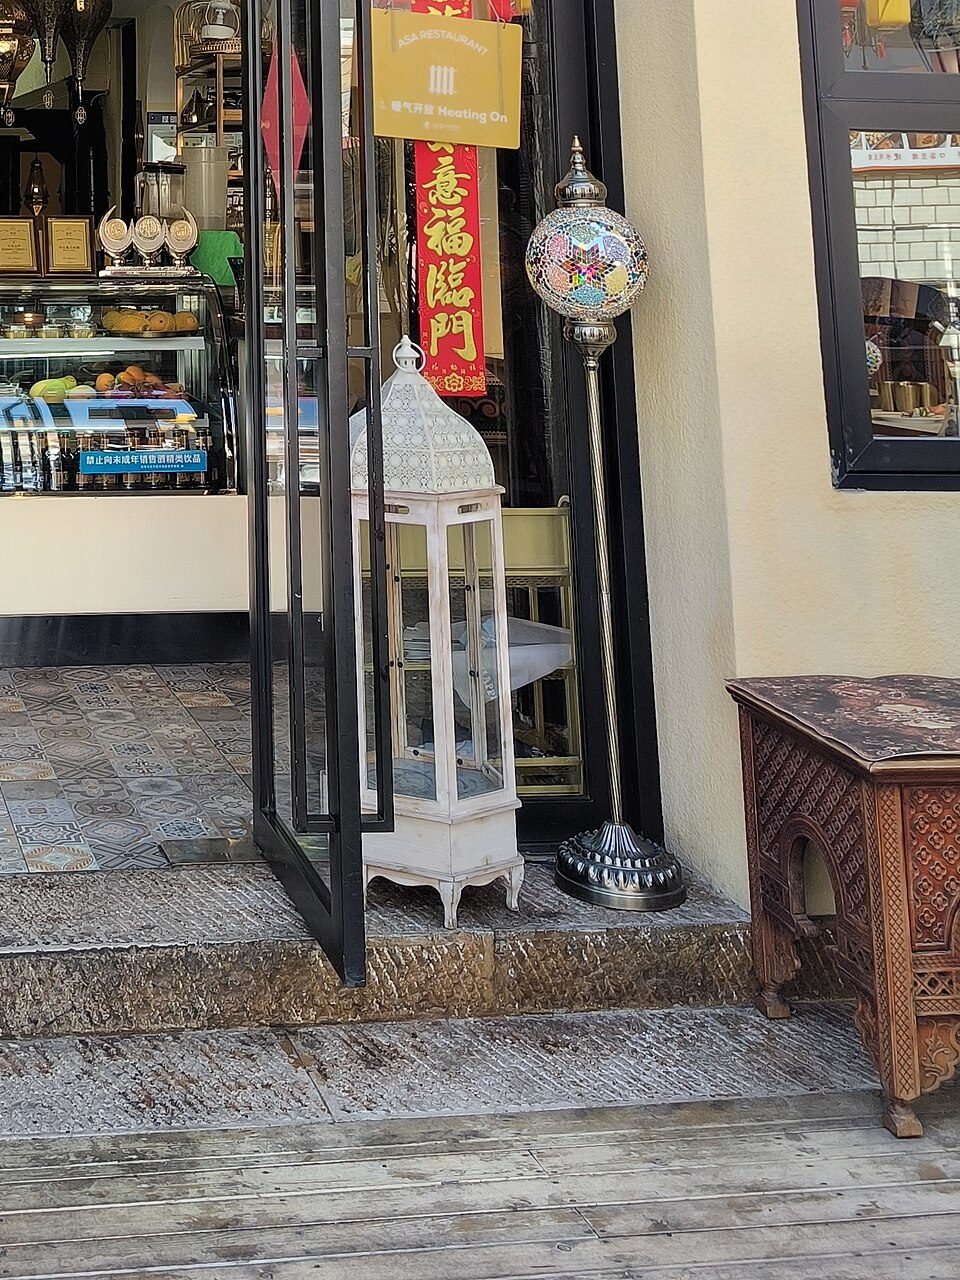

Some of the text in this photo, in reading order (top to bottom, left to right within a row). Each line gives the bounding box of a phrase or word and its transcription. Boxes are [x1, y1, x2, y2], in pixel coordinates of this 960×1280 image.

[397, 29, 489, 56] ASA RESTAURANT
[438, 105, 487, 124] Heating
[490, 111, 508, 123] On
